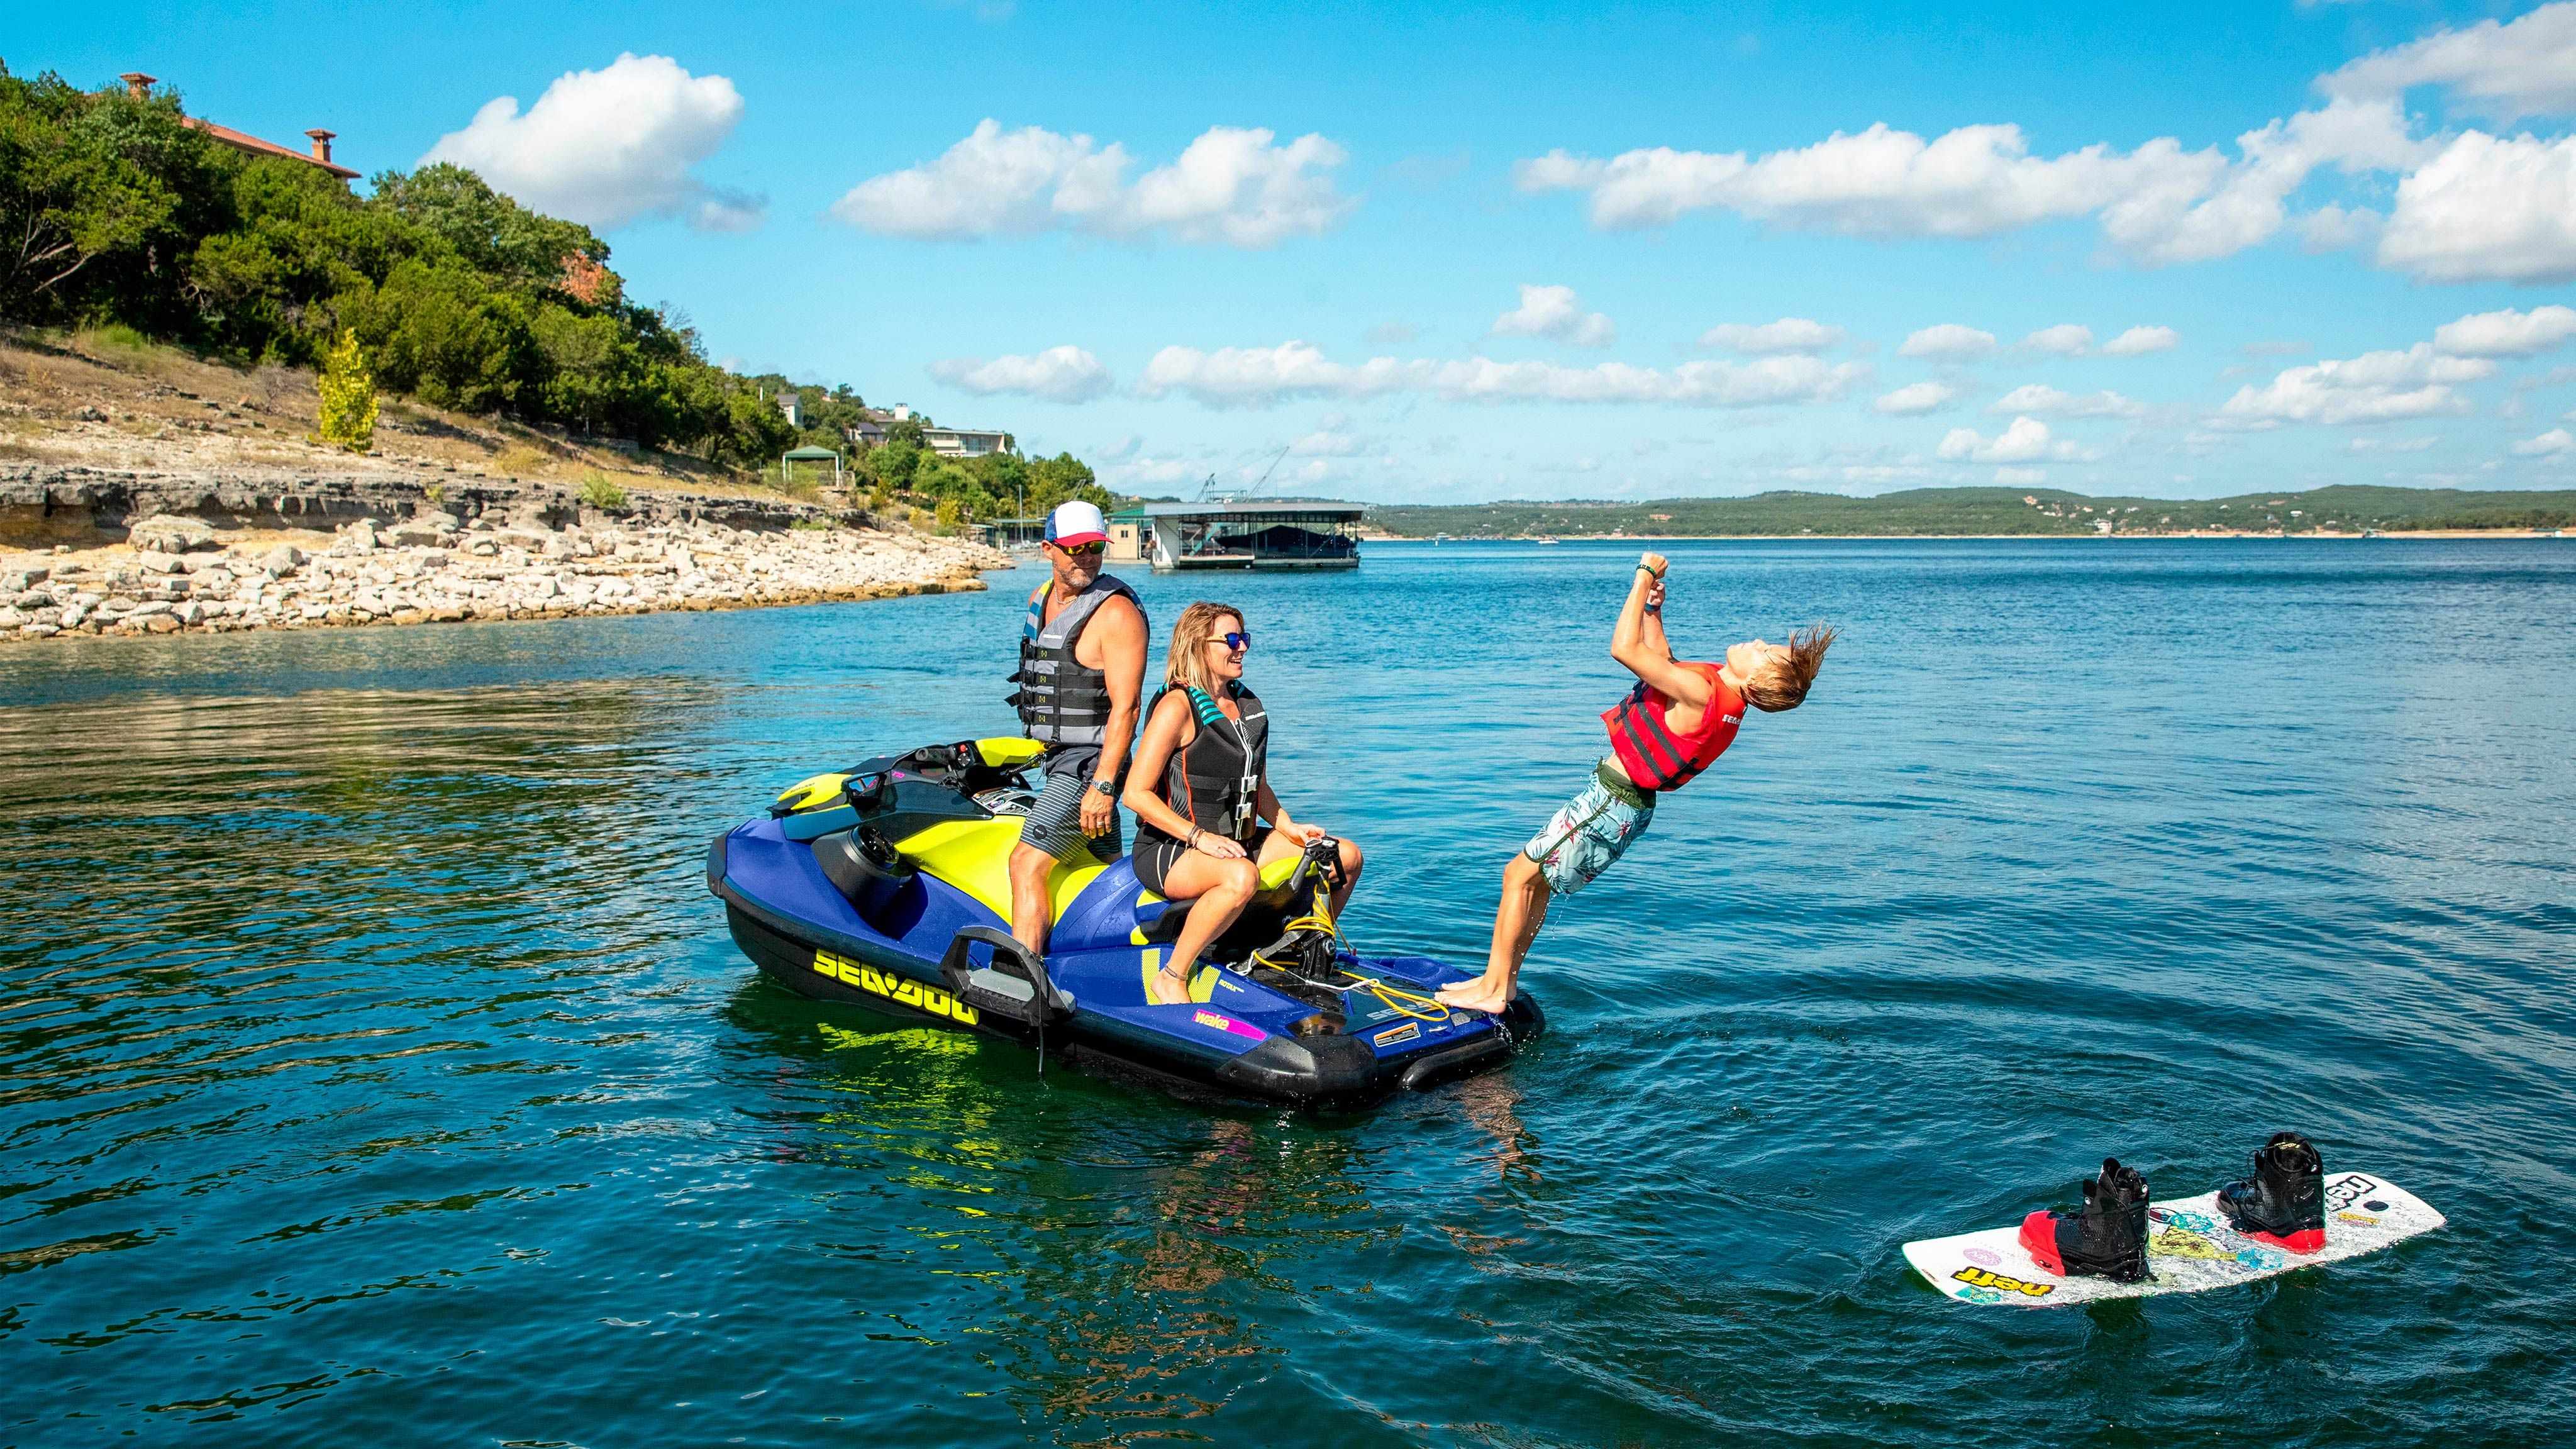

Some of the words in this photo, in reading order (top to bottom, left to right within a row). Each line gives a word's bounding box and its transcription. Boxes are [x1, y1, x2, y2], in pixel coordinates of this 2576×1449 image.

[1218, 979, 1236, 992] ROTAX
[1196, 1011, 1230, 1030] wake
[1951, 1266, 2055, 1297] neff
